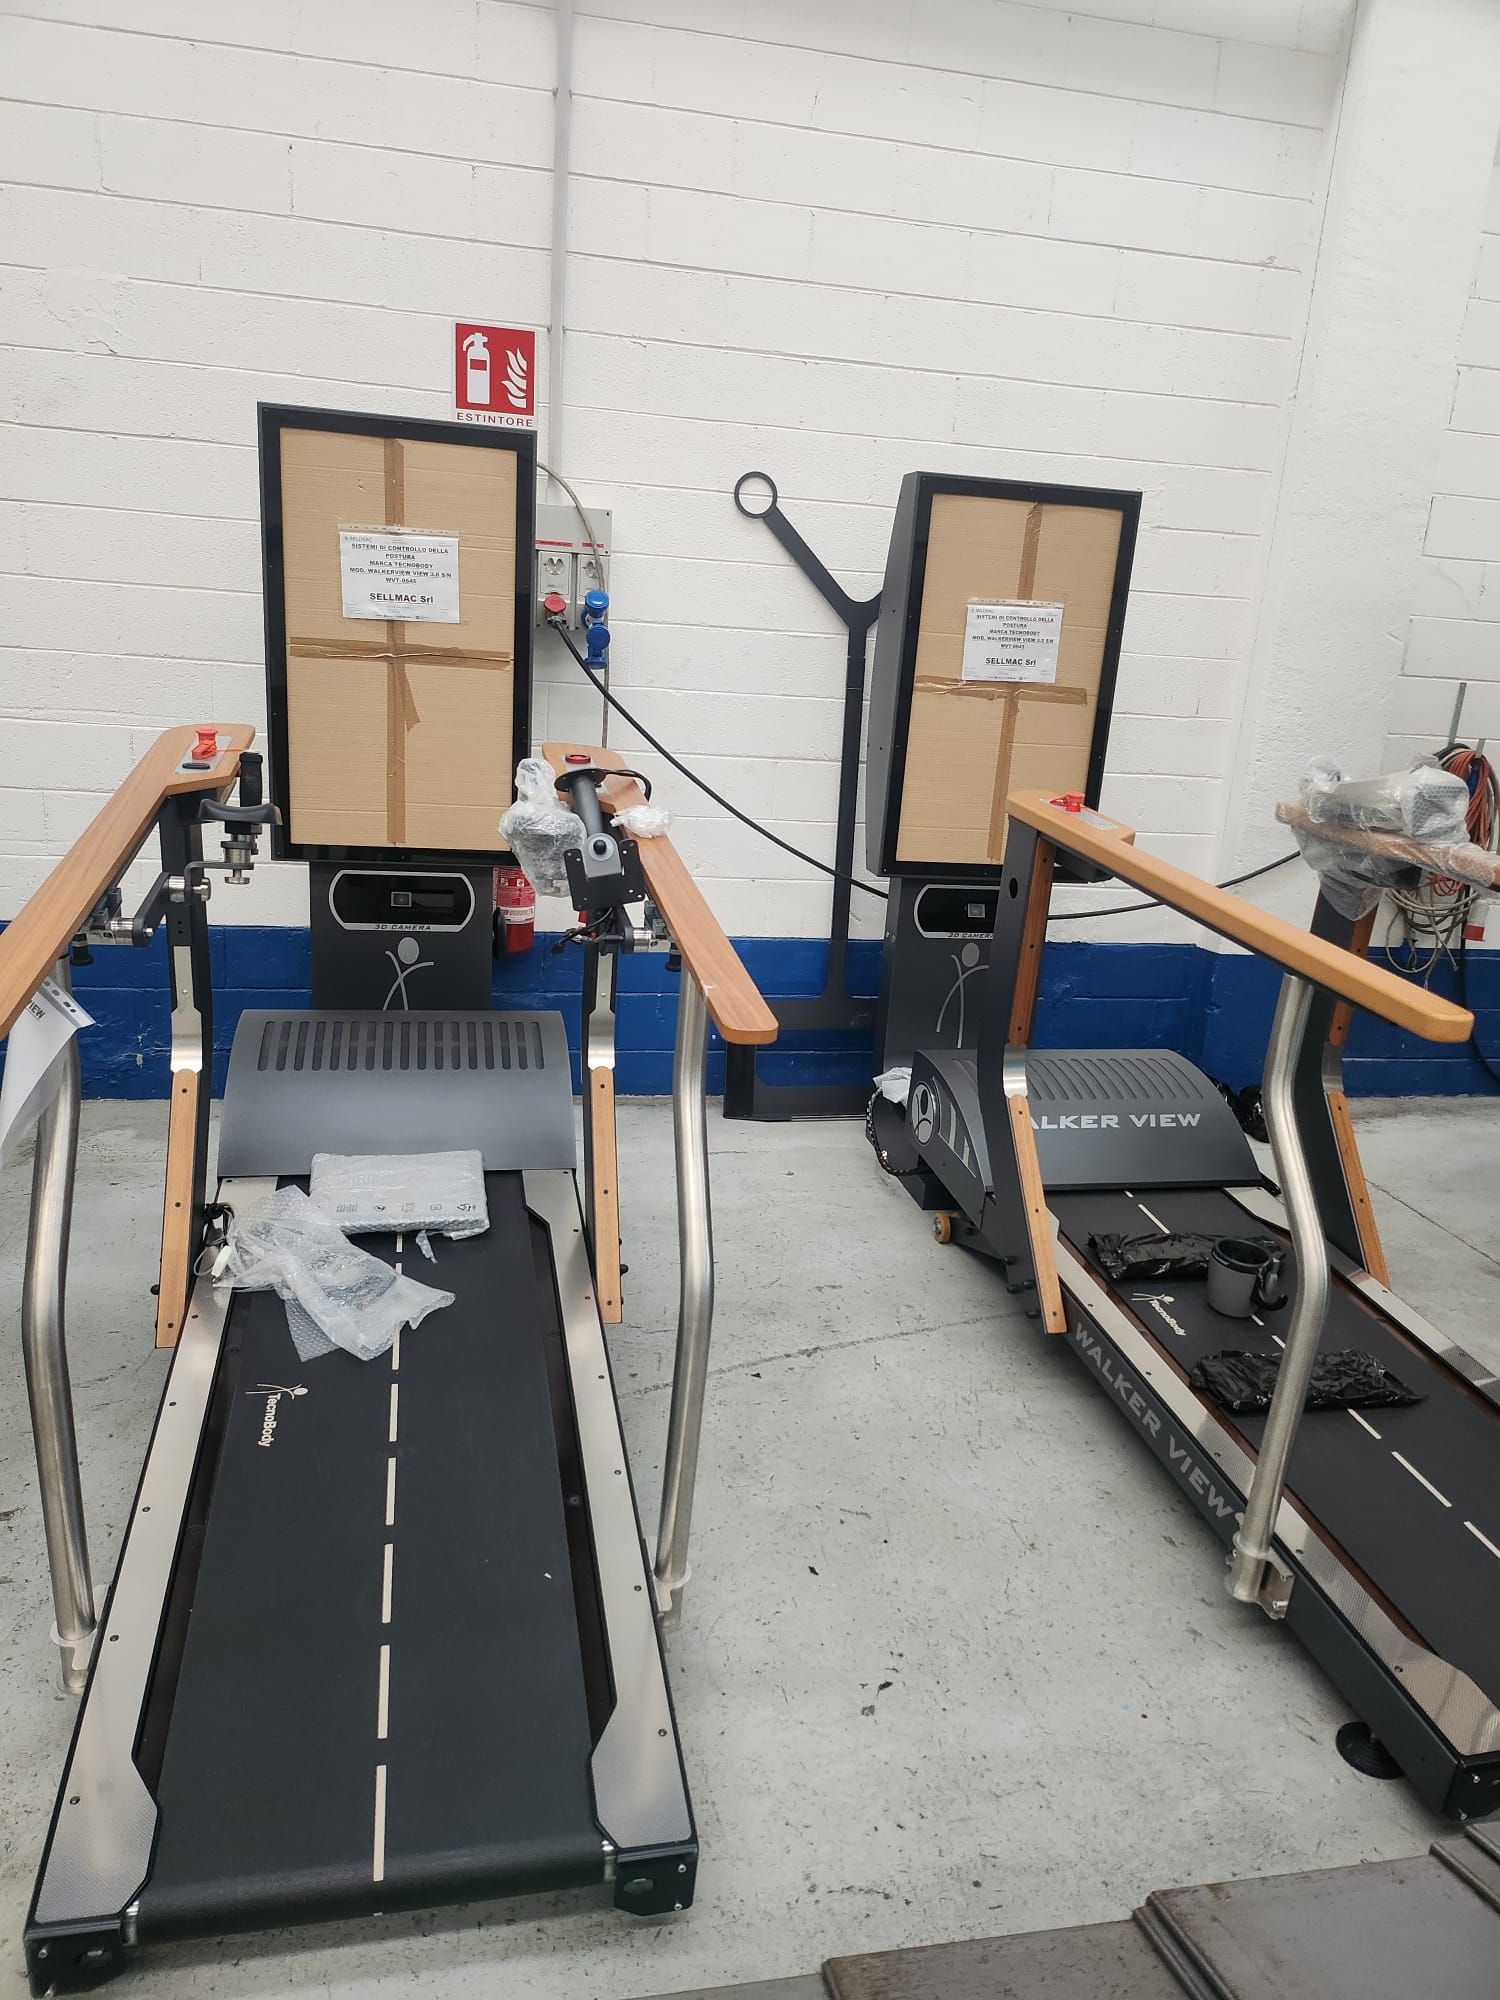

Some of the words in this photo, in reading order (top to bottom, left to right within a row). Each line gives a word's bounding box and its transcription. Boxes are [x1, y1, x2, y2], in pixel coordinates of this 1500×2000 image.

[457, 412, 533, 427] ESTINTORE
[387, 545, 427, 553] CONTROLLO
[394, 561, 434, 569] TECNOBODY
[367, 568, 411, 576] WALKERVIEW
[369, 592, 417, 602] SELLMAC
[420, 595, 434, 603] Srl
[985, 657, 1023, 666] SELLMAC
[28, 1001, 46, 1019] IEW
[1030, 1115, 1120, 1129] LKER
[1129, 1113, 1200, 1128] VIEW
[258, 1392, 281, 1447] TecnoBody
[1075, 1322, 1163, 1439] WALKER
[1169, 1435, 1234, 1518] VIEW
